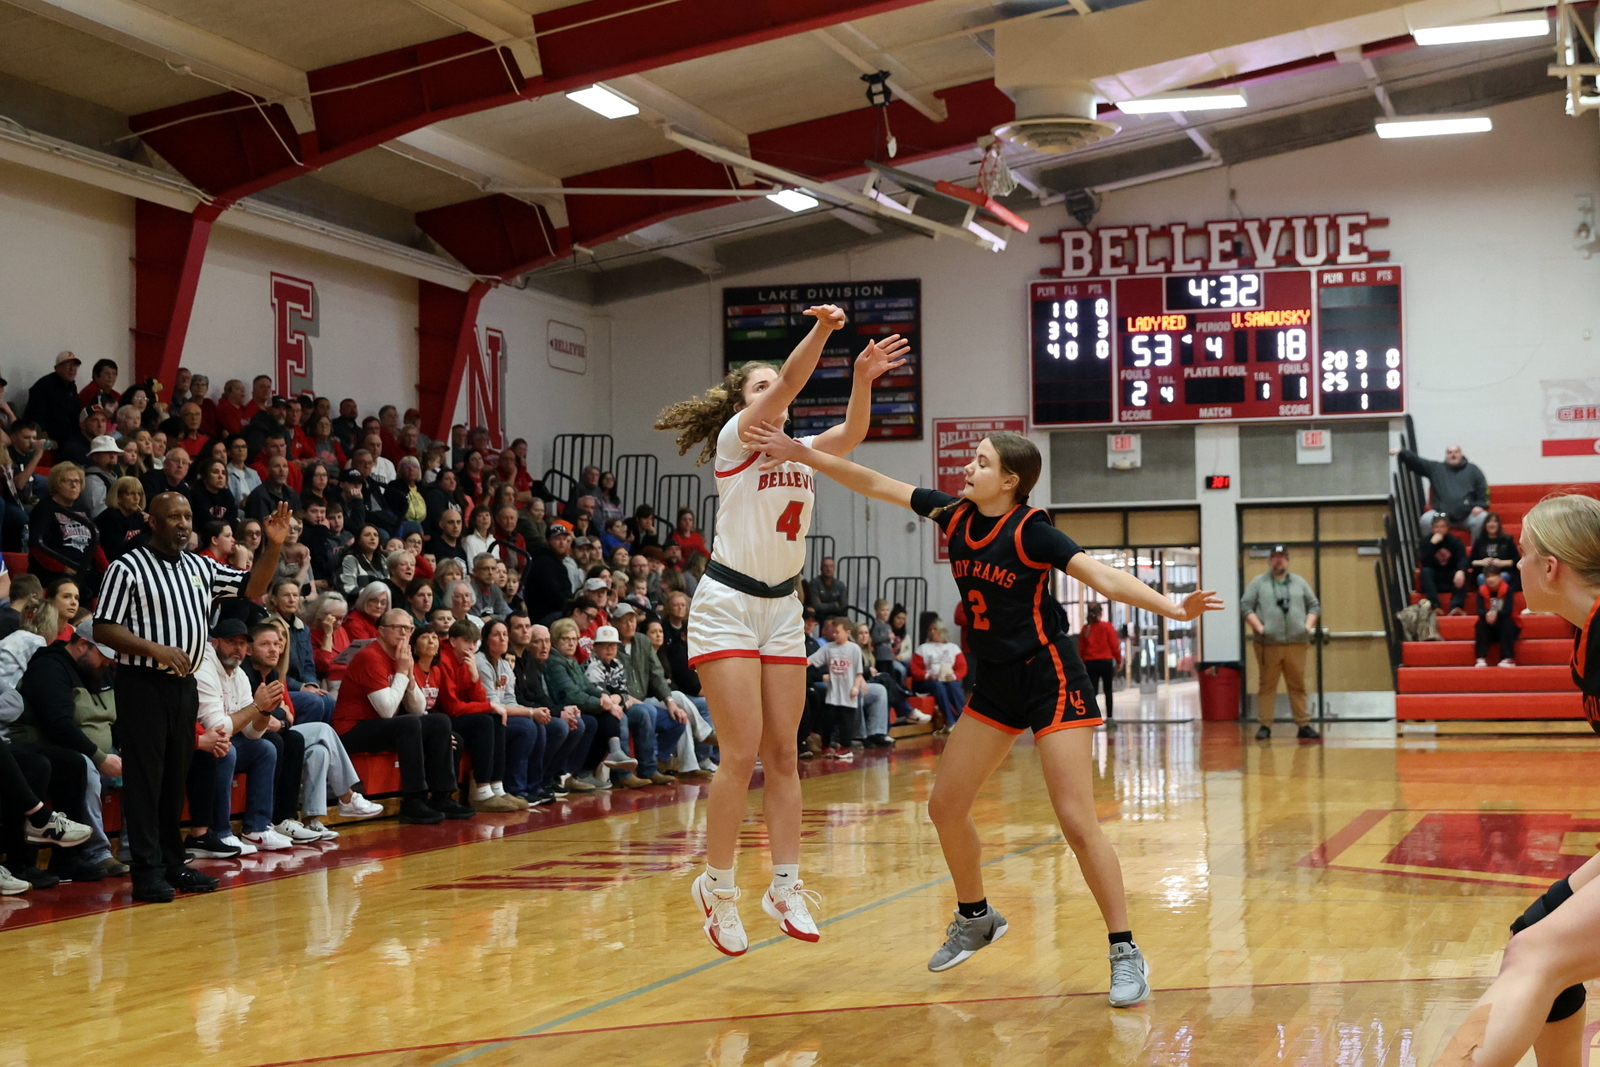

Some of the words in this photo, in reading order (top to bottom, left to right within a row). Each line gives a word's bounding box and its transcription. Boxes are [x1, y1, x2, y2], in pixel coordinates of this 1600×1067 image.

[1060, 214, 1371, 278] BELLEVUE
[1351, 270, 1367, 283] FLS
[1376, 269, 1393, 282] PTS
[759, 290, 798, 301] LAKE
[807, 286, 884, 299] DIVISION
[1188, 273, 1259, 308] 4:32
[1052, 301, 1060, 319] 1
[1064, 299, 1078, 320] 0
[1095, 297, 1109, 318] 0
[1048, 321, 1060, 341] 3
[1064, 321, 1078, 338] 4
[1097, 318, 1109, 339] 3
[1195, 321, 1232, 333] PERIOD
[1046, 342, 1061, 360] 4
[1065, 340, 1079, 361] 0
[1095, 339, 1110, 360] 0
[1131, 334, 1172, 367] 53
[1205, 336, 1223, 359] 4
[1277, 329, 1306, 361] 18
[1278, 362, 1310, 374] FOULS
[1322, 350, 1348, 371] 20
[1355, 349, 1368, 370] 3
[1386, 347, 1400, 369] 0
[1120, 368, 1152, 380] FOULS
[1184, 366, 1220, 378] PLAYER
[1223, 365, 1248, 377] FOUL
[1322, 371, 1349, 392] 25
[1360, 372, 1368, 389] 1
[1386, 369, 1400, 390] 0
[1131, 380, 1148, 407] 2
[1160, 386, 1174, 403] 4
[1262, 382, 1270, 400] 1
[1299, 376, 1307, 399] 1
[1199, 406, 1233, 418] MATCH
[1279, 403, 1311, 416] SCORE
[1361, 393, 1369, 410] 1
[1121, 410, 1153, 421] SCORE
[1114, 434, 1133, 451] EXIT
[1304, 430, 1324, 446] EXIT
[775, 500, 804, 541] 4
[972, 560, 1017, 588] RAMS
[967, 589, 990, 631] 2
